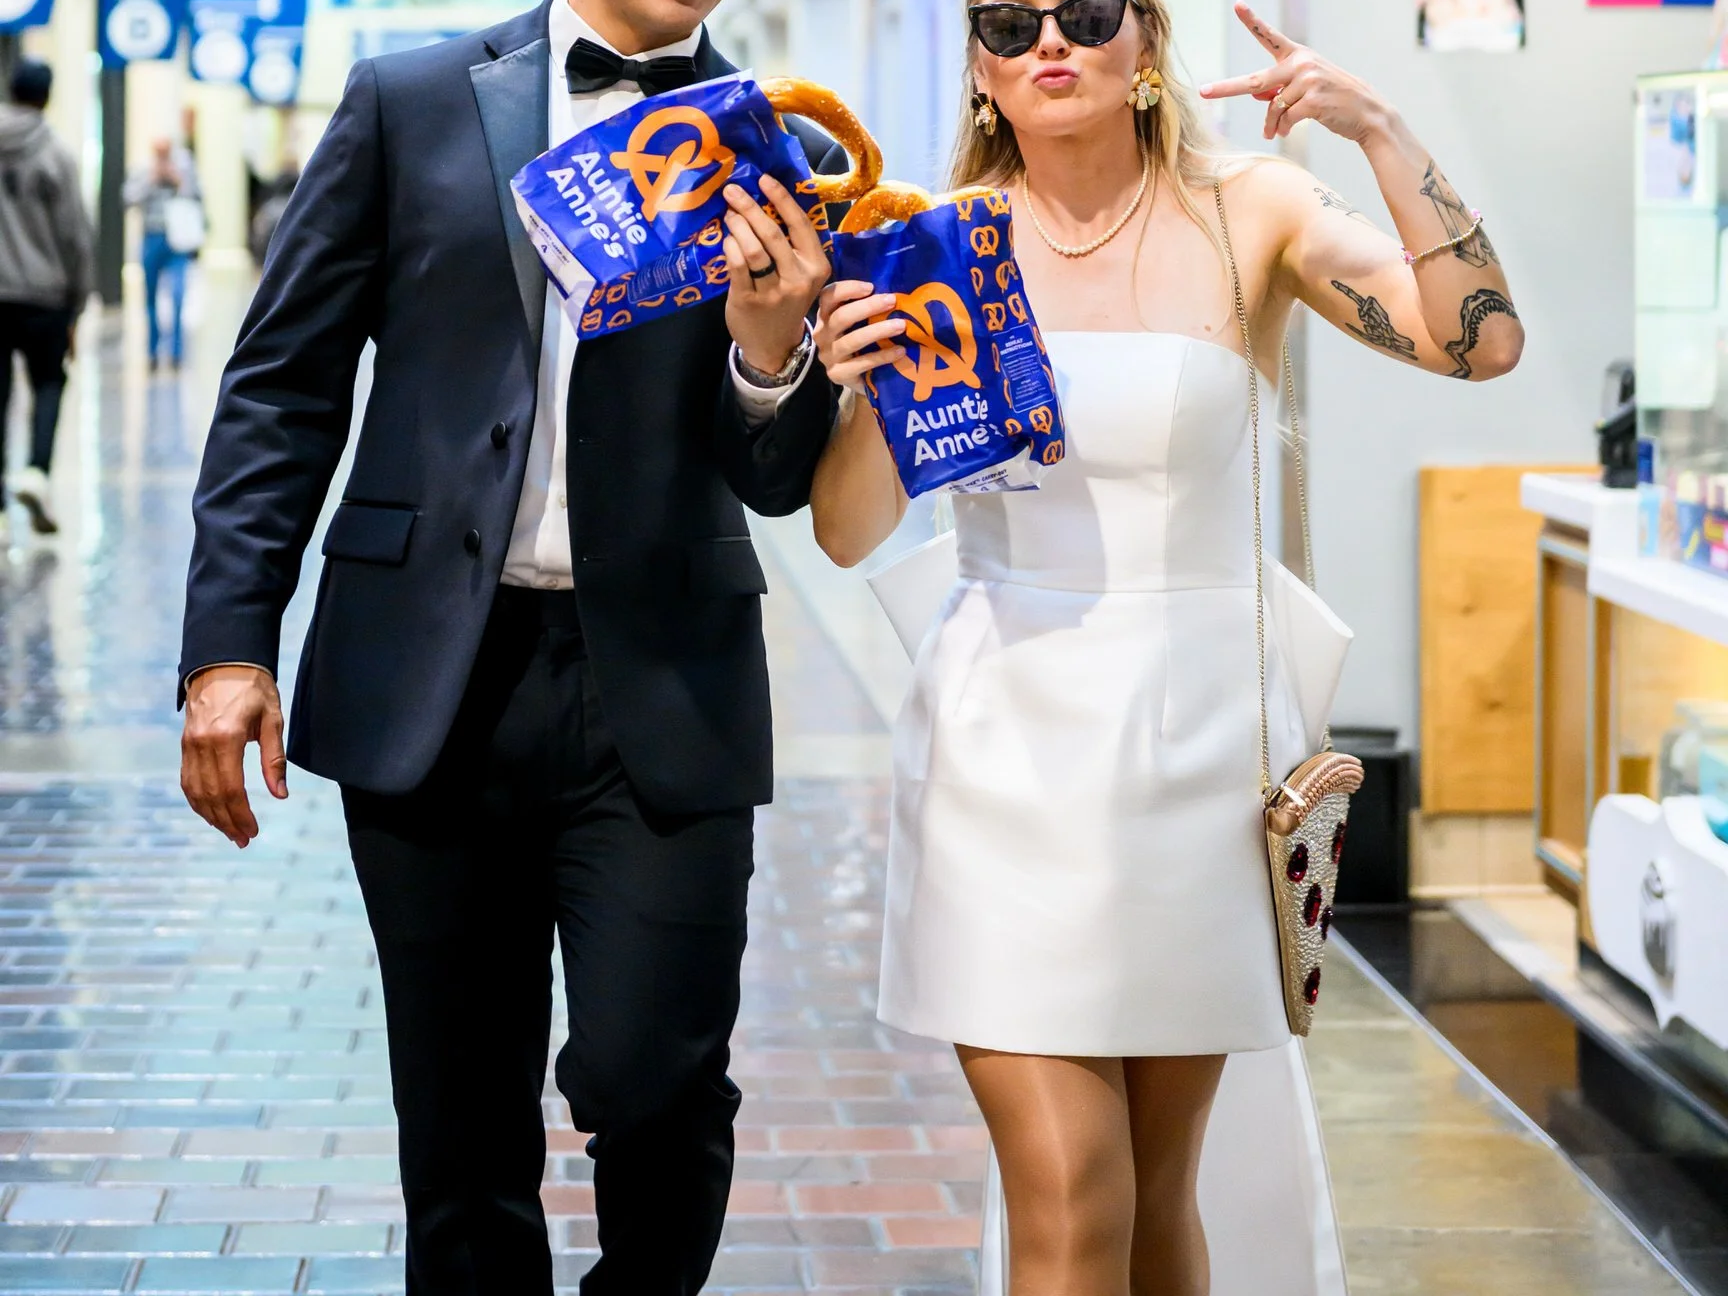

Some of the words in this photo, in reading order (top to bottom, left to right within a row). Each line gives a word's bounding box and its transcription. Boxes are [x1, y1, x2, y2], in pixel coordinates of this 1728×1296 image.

[546, 167, 626, 258] Anne's
[571, 151, 648, 245] Auntie
[905, 392, 989, 439] Auntie
